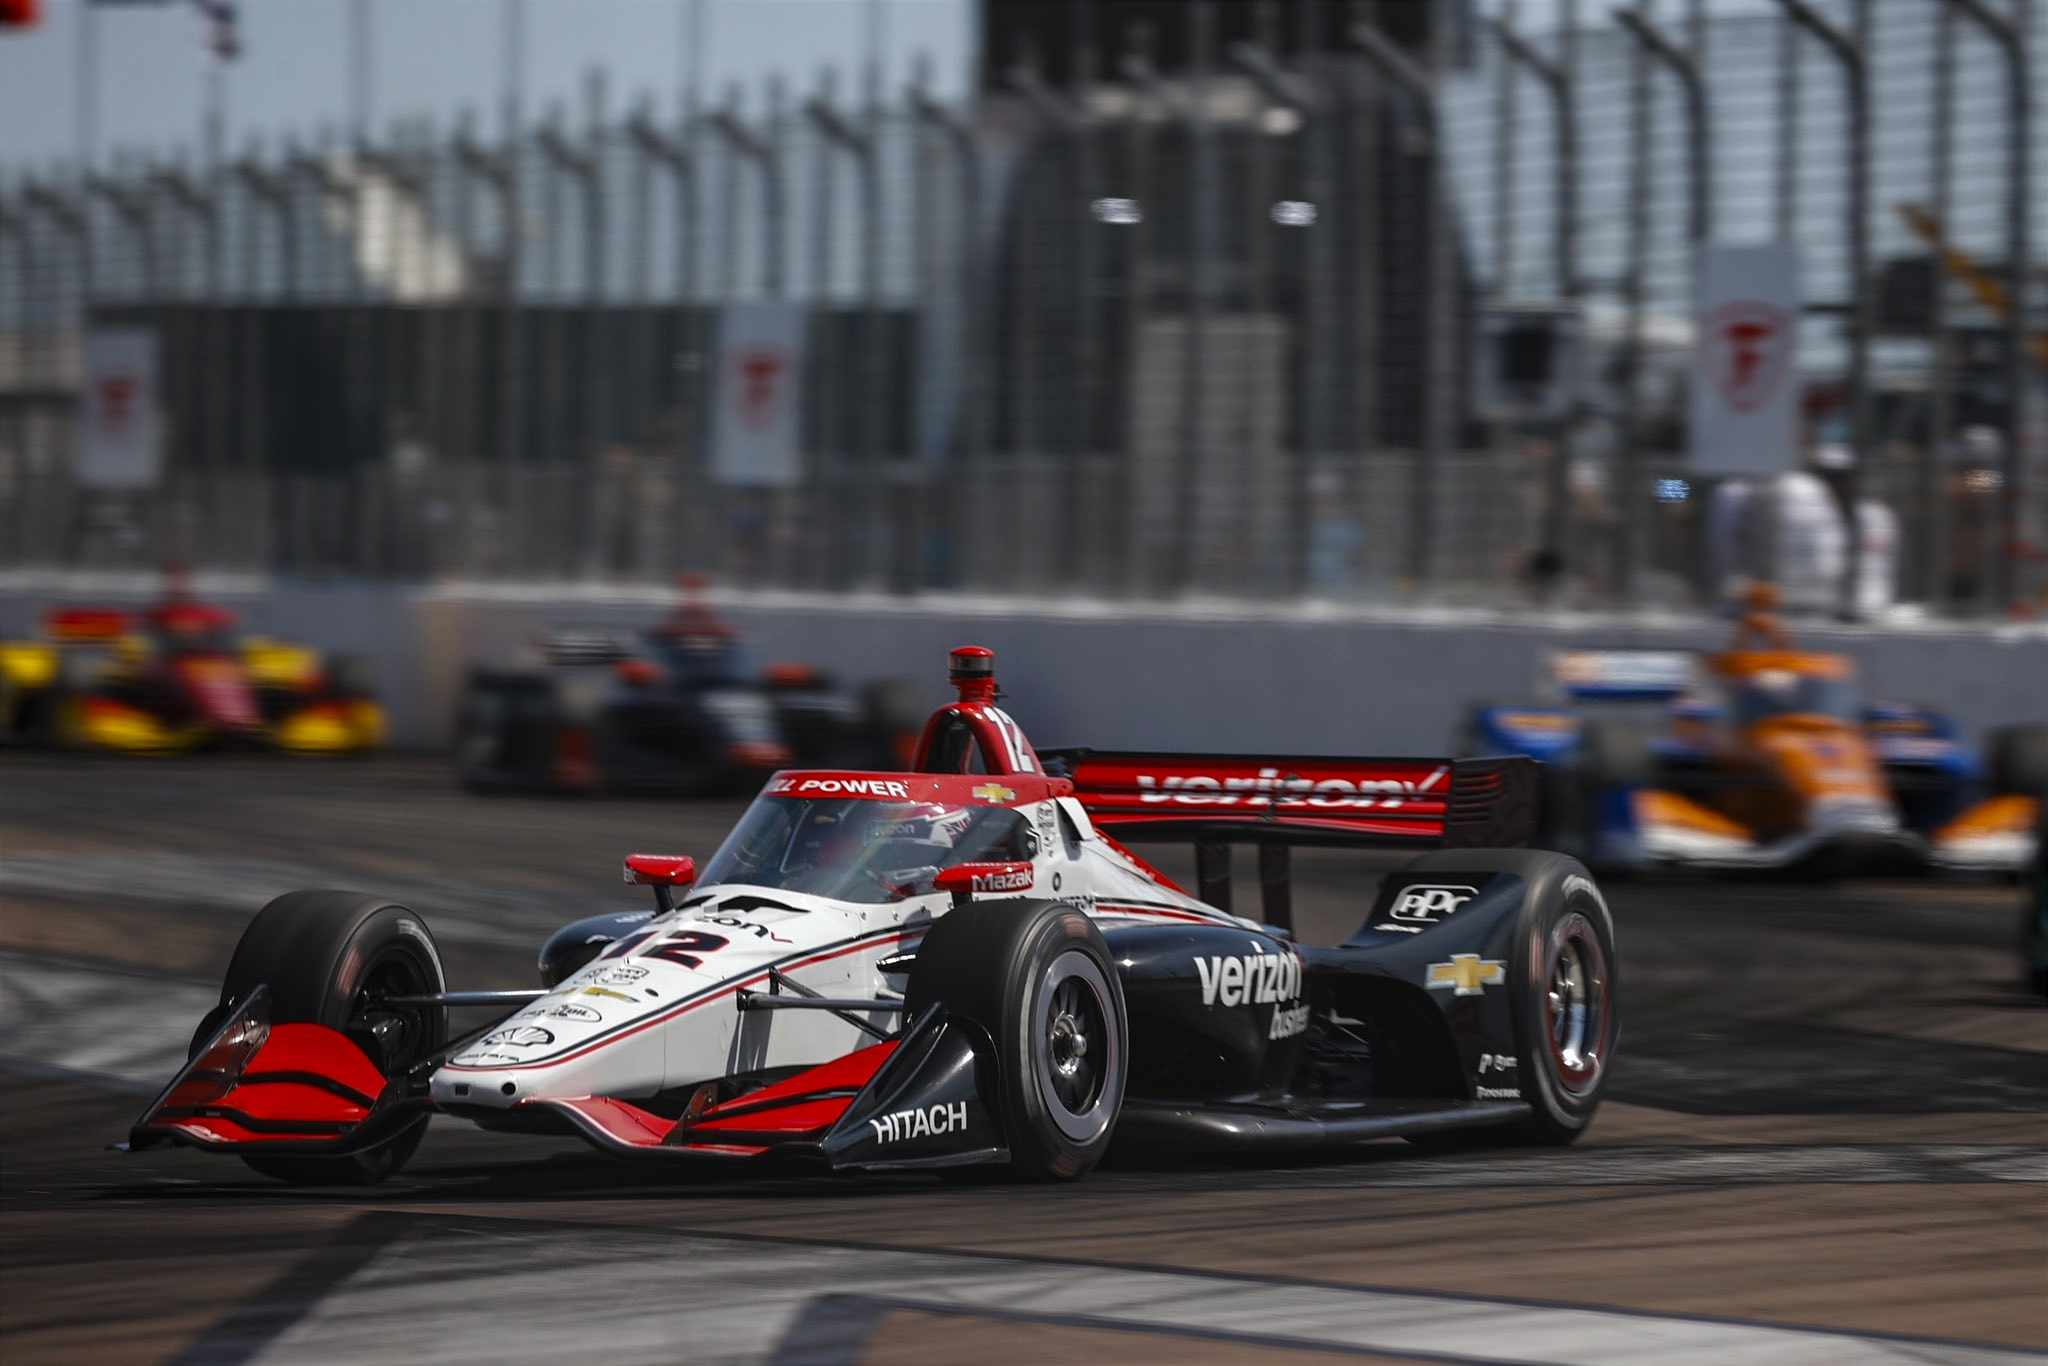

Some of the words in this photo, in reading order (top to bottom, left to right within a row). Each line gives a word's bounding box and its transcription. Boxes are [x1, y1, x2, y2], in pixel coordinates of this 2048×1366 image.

[982, 706, 1035, 772] 12
[799, 780, 908, 798] POWER
[971, 868, 1032, 892] Mazak
[600, 929, 731, 970] 12
[1193, 941, 1302, 1007] verizon
